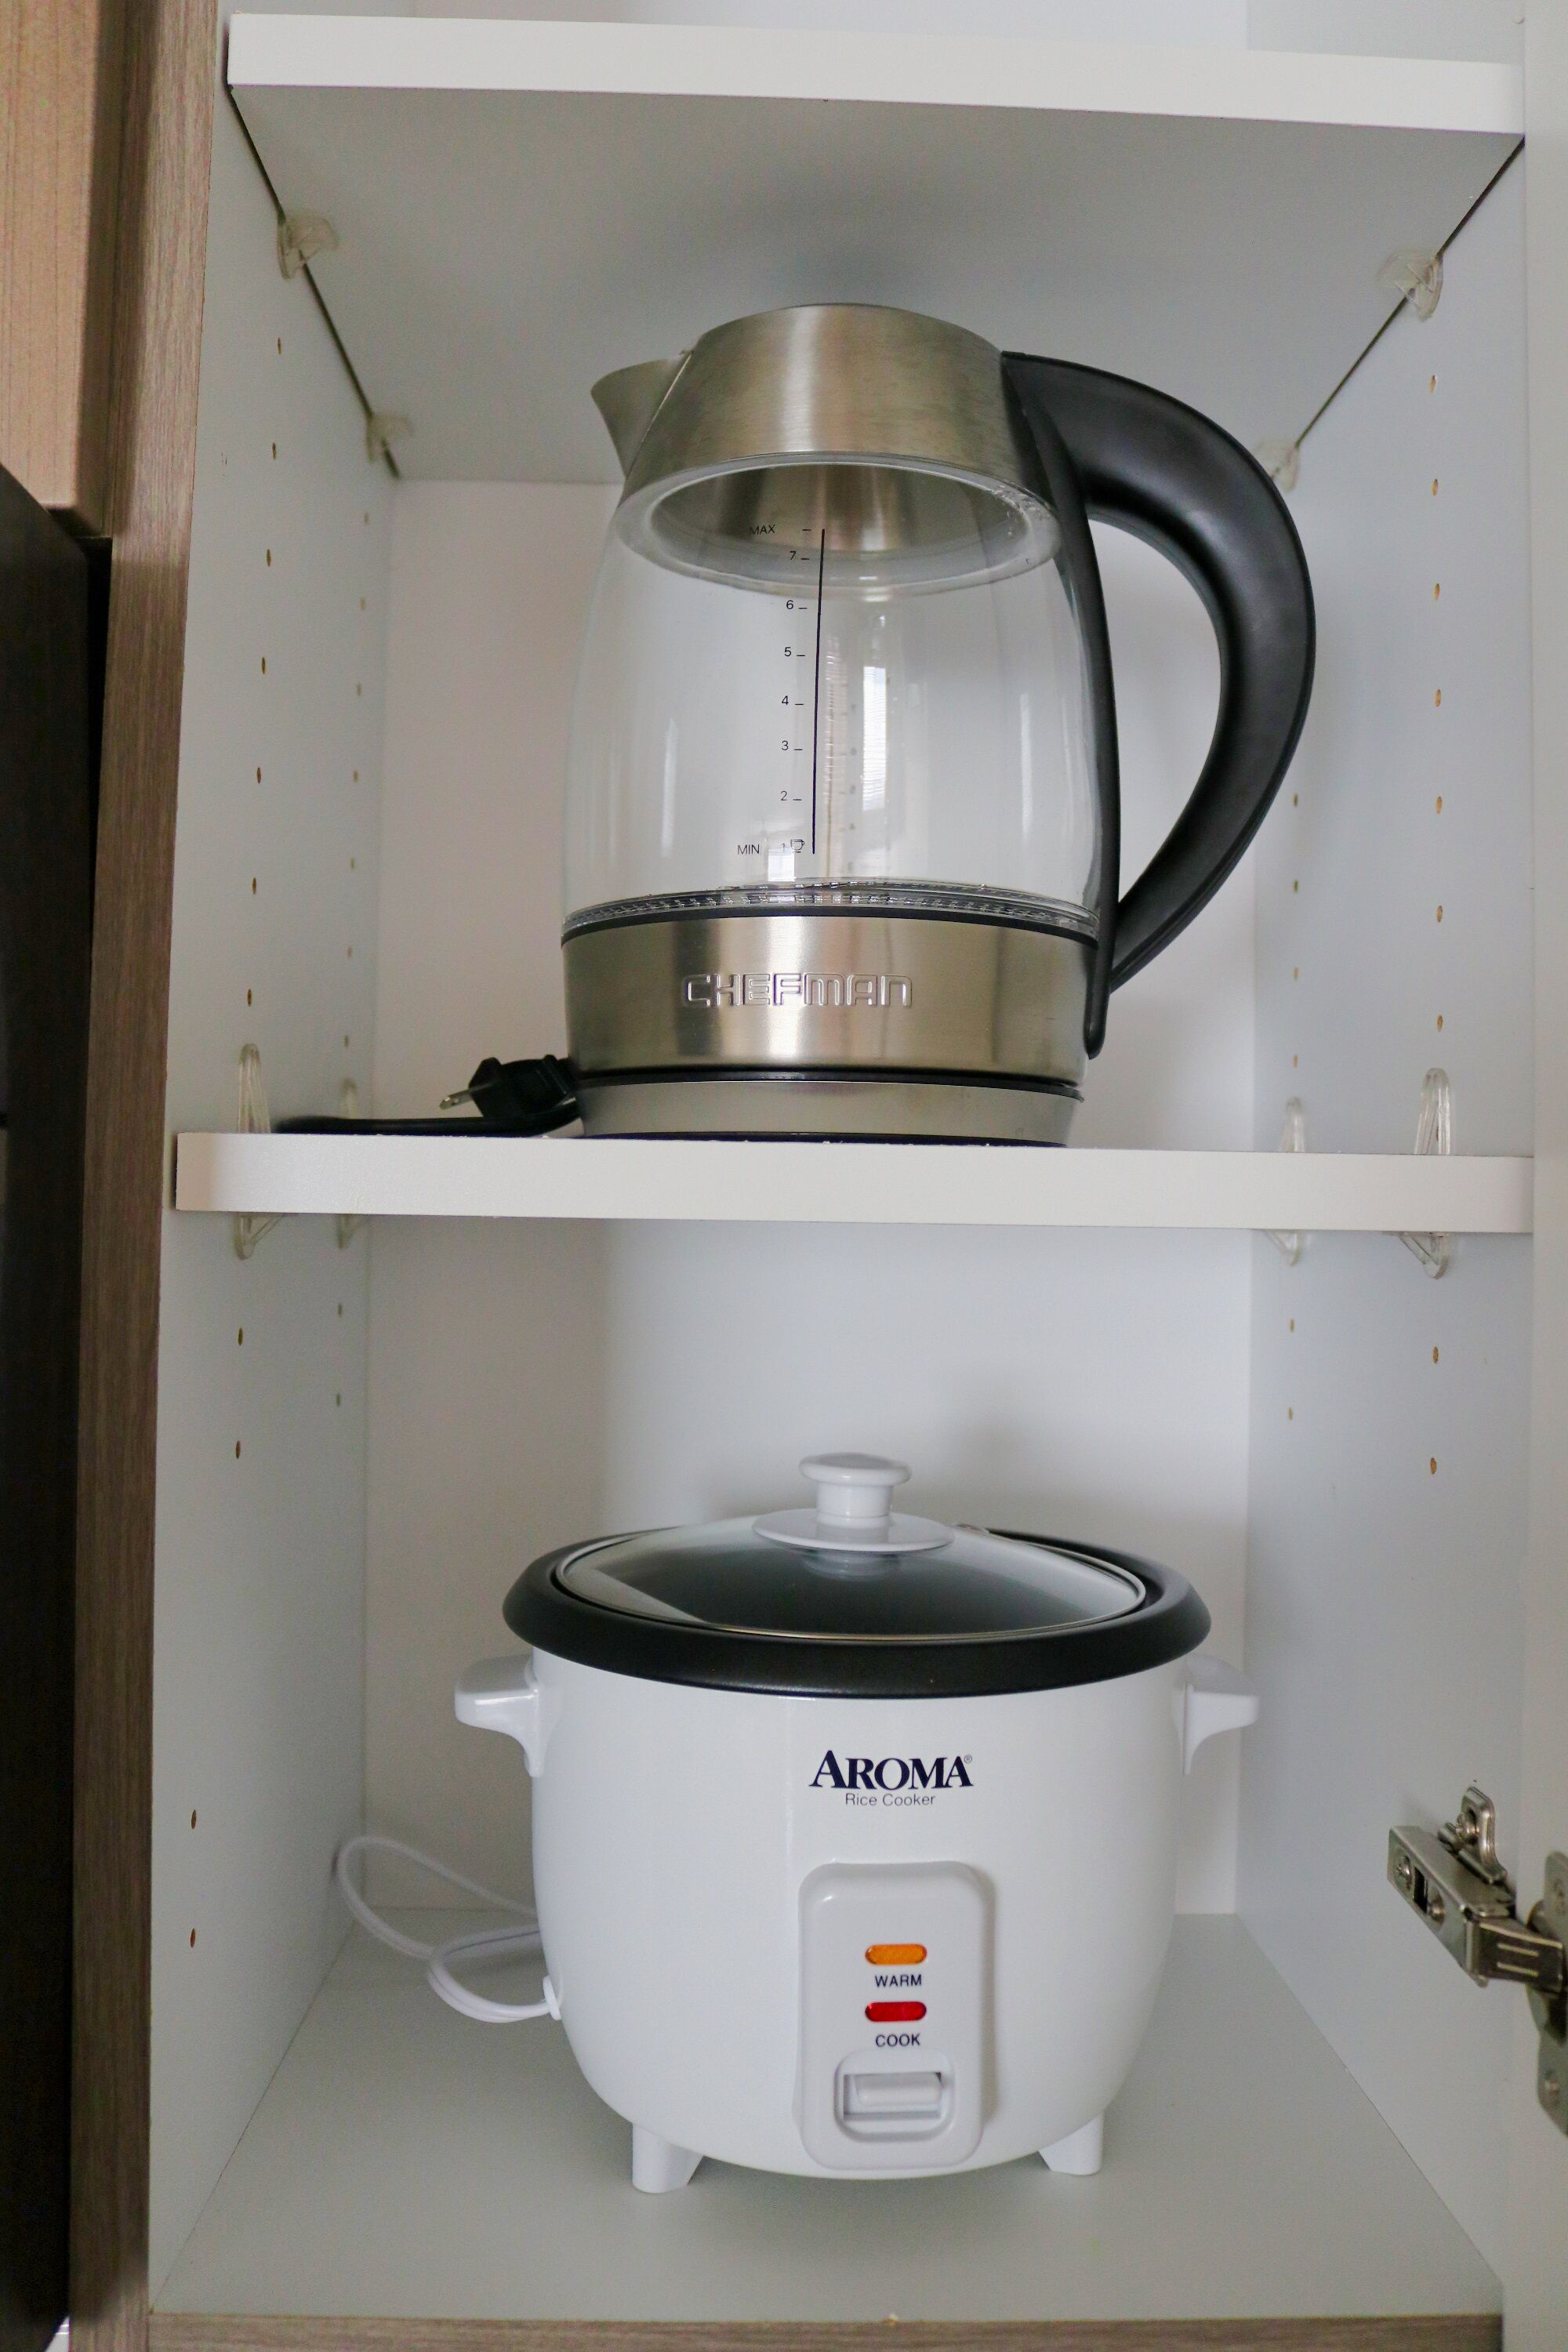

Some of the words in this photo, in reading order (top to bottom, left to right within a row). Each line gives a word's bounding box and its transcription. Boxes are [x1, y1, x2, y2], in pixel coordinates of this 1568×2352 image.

[749, 524, 776, 535] MAX
[789, 550, 797, 561] 7
[786, 599, 794, 610] 6
[784, 646, 792, 657] 5
[781, 695, 789, 706] 4
[781, 740, 789, 751] 3
[780, 790, 788, 801] 2
[737, 844, 760, 855] MIN
[684, 973, 913, 1007] CHEFMAN
[845, 1792, 877, 1806] Rice
[882, 1793, 935, 1806] Cooker
[874, 1974, 923, 1988] WARM
[875, 2034, 921, 2048] COOK
